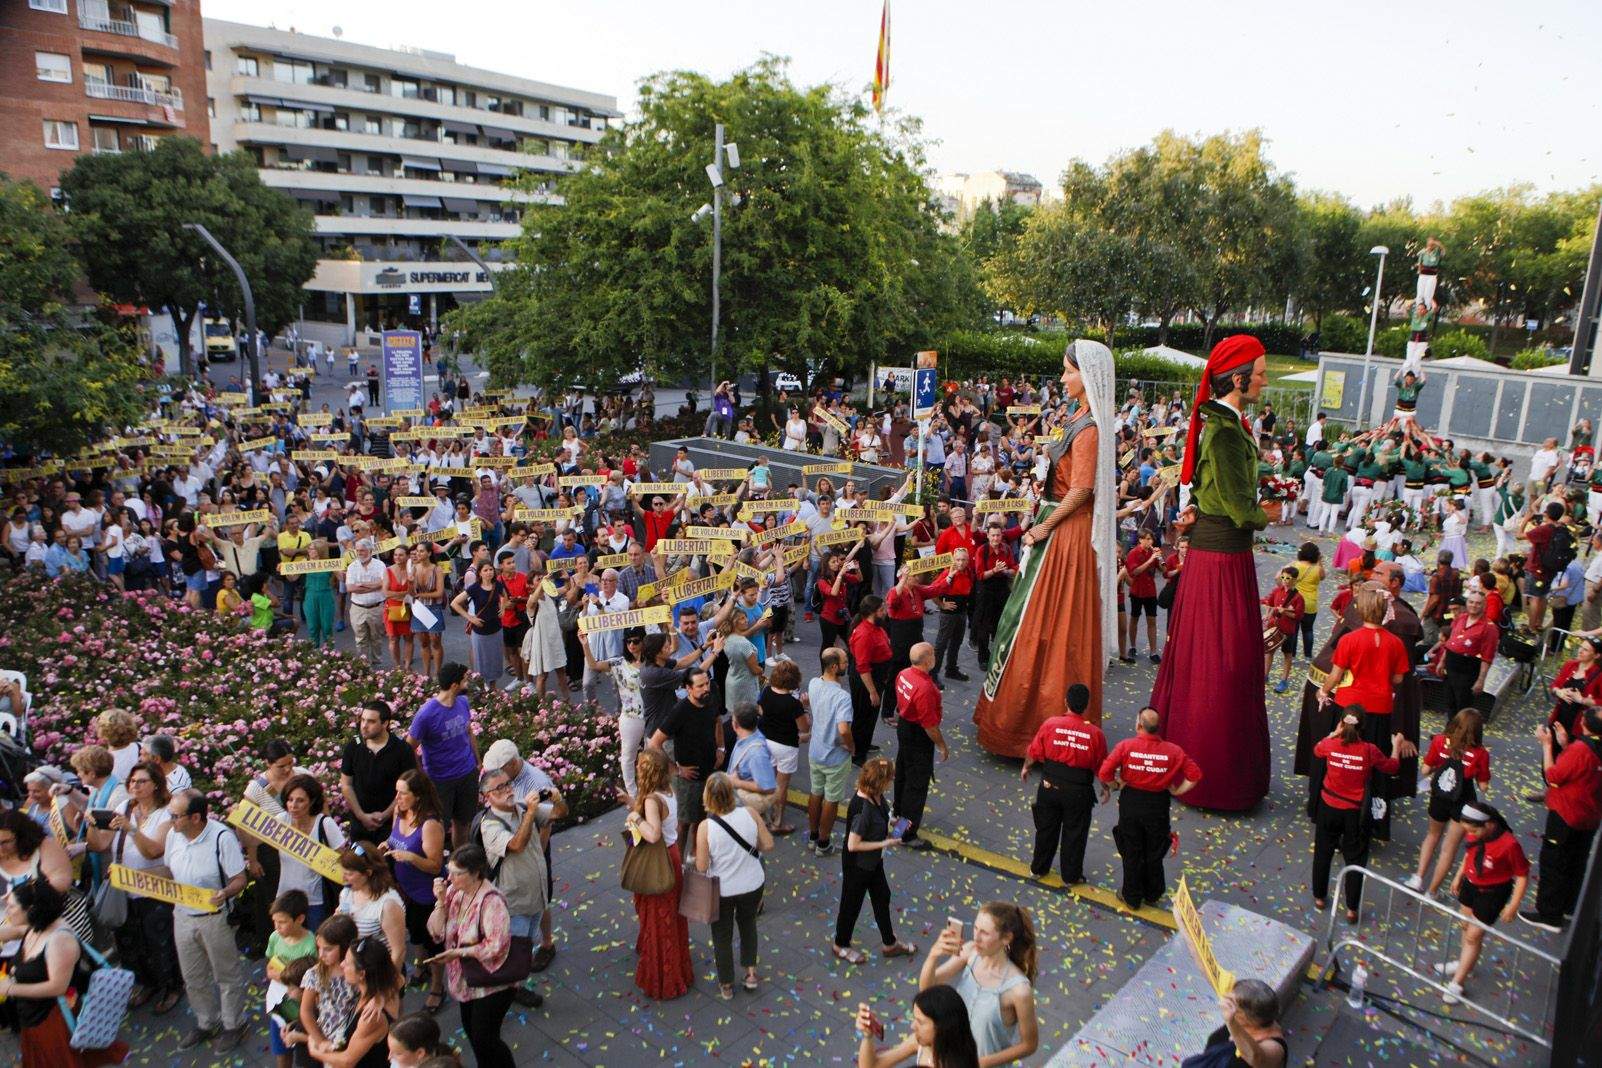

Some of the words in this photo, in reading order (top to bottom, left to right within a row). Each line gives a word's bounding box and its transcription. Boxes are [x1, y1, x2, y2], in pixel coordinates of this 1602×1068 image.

[410, 272, 470, 283] SUPERMERCAT
[410, 296, 418, 306] P
[704, 469, 735, 478] LLIBERTAT!
[808, 464, 838, 473] LLIBERTAT!
[644, 483, 662, 491] VOLEM
[870, 500, 907, 513] LLIBERTAT!
[221, 513, 240, 521] VOLEM
[840, 509, 878, 518] LLIBERTAT!
[411, 530, 444, 544] LLIBERTAT!
[700, 528, 719, 536] VOLEM
[756, 526, 791, 542] LLIBERTAT!
[664, 540, 713, 552] LLIBERTAT!
[285, 564, 294, 573] US
[295, 561, 317, 571] VOLEM
[673, 576, 719, 599] LLIBERTAT!
[585, 610, 645, 631] LLIBERTAT!
[1130, 752, 1168, 760] GEGANTERS
[242, 806, 321, 862] LLIBERTAT!
[118, 867, 183, 900] LLIBERTAT!
